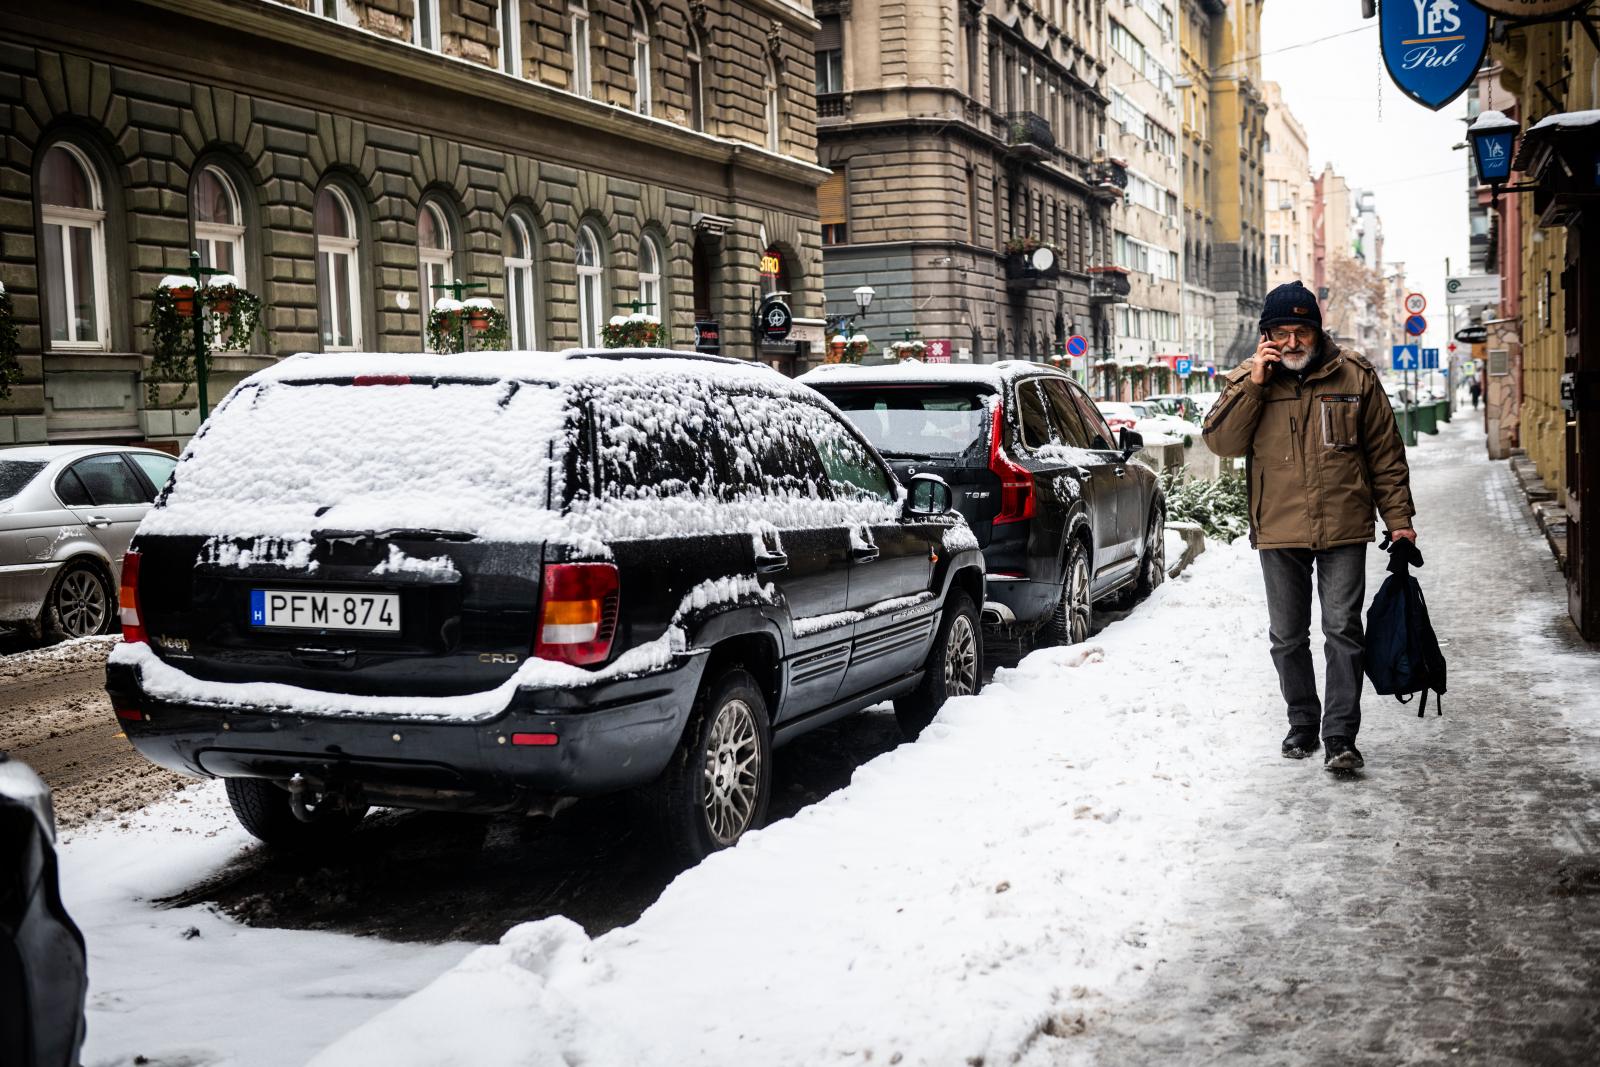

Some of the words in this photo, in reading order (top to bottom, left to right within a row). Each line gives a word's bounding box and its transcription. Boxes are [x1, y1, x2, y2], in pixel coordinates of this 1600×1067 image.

[1402, 43, 1466, 69] Pub
[1411, 299, 1422, 309] 30
[1180, 361, 1189, 373] P
[254, 610, 262, 620] H
[270, 595, 393, 626] PFM-874
[160, 634, 190, 652] Jeep
[479, 653, 519, 664] CRD
